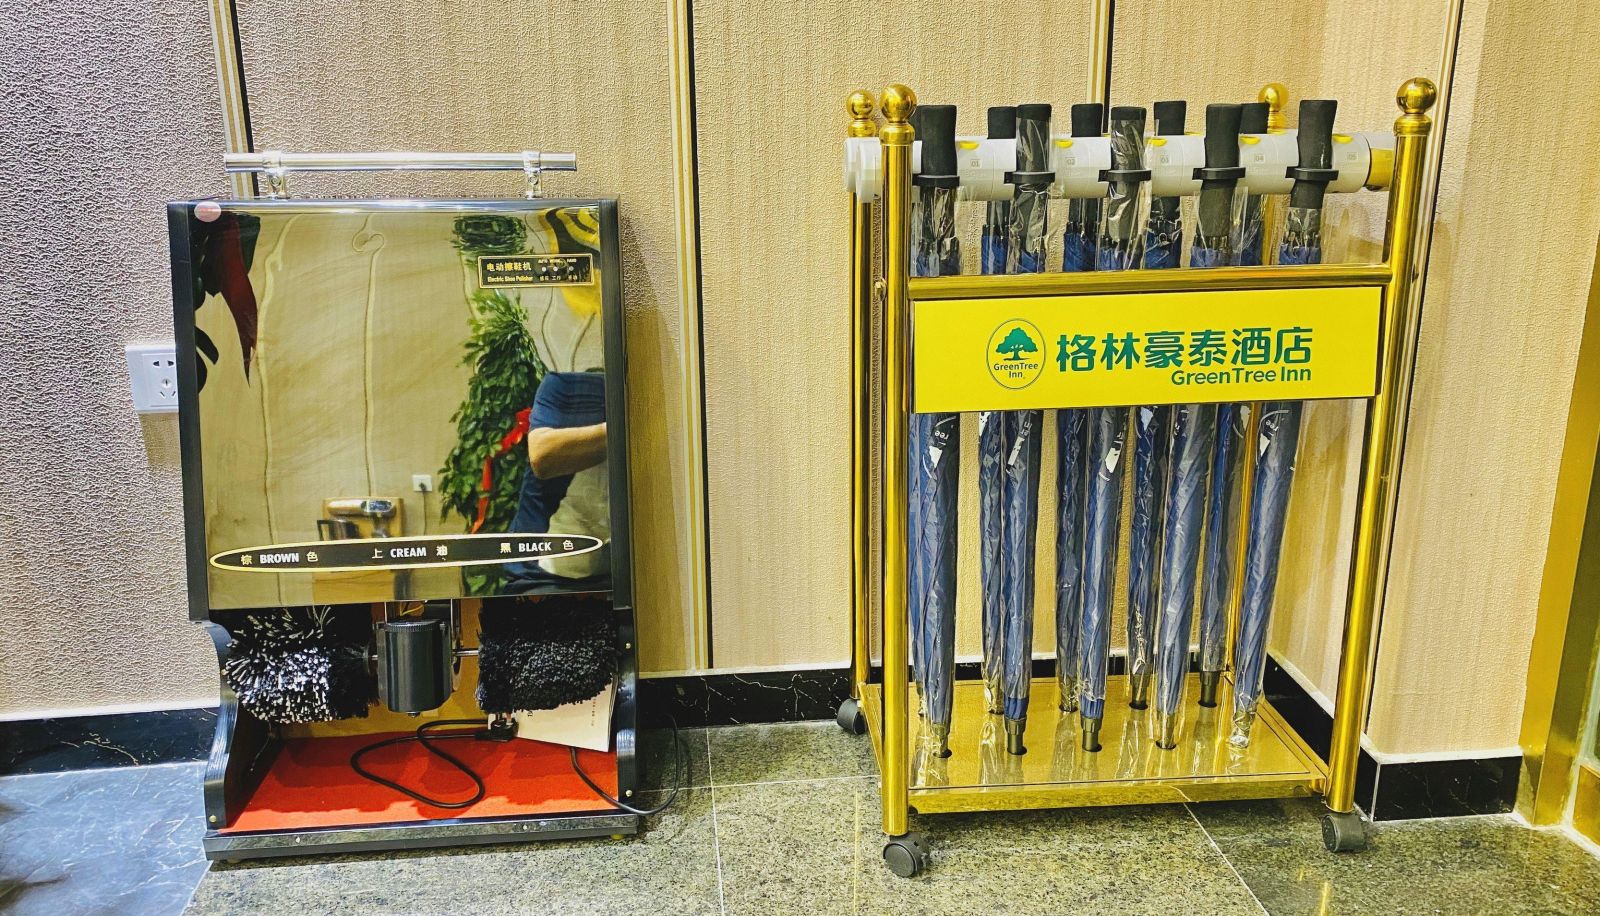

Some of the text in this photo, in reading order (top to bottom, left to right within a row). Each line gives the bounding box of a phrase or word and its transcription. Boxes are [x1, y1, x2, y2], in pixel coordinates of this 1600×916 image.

[971, 160, 980, 168] 01
[1056, 326, 1313, 372] 格林豪泰酒店
[993, 362, 1039, 371] GreenTree
[1008, 371, 1023, 379] Inn
[1171, 366, 1312, 386] GreenTree Inn
[240, 539, 574, 566] 棕 BROWN 色 上 CREAM 油 黑 BLACK 色
